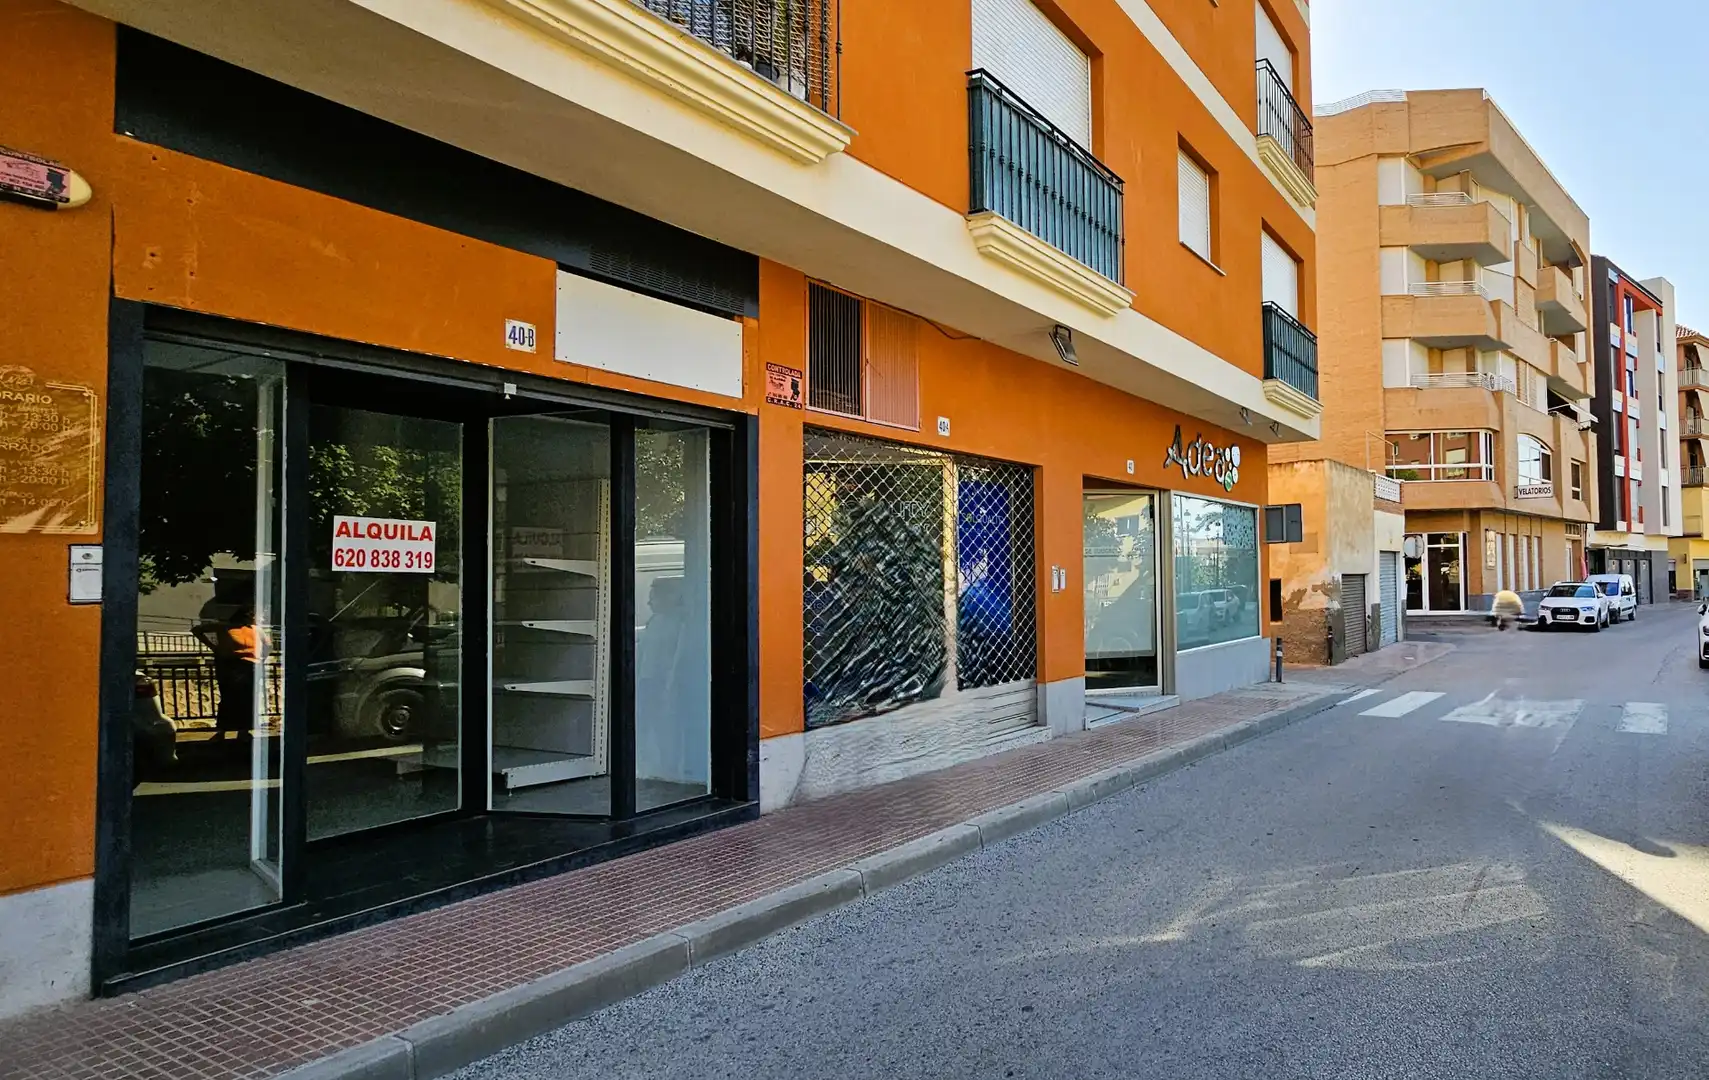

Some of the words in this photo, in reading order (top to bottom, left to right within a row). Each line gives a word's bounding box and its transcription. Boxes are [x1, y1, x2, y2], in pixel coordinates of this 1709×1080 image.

[508, 325, 535, 347] 40-B
[0, 391, 52, 404] RARIO
[1519, 487, 1551, 495] VELATORIOS
[335, 521, 433, 541] ALQUILA
[334, 548, 366, 568] 620
[370, 549, 400, 568] 838
[404, 550, 433, 569] 319
